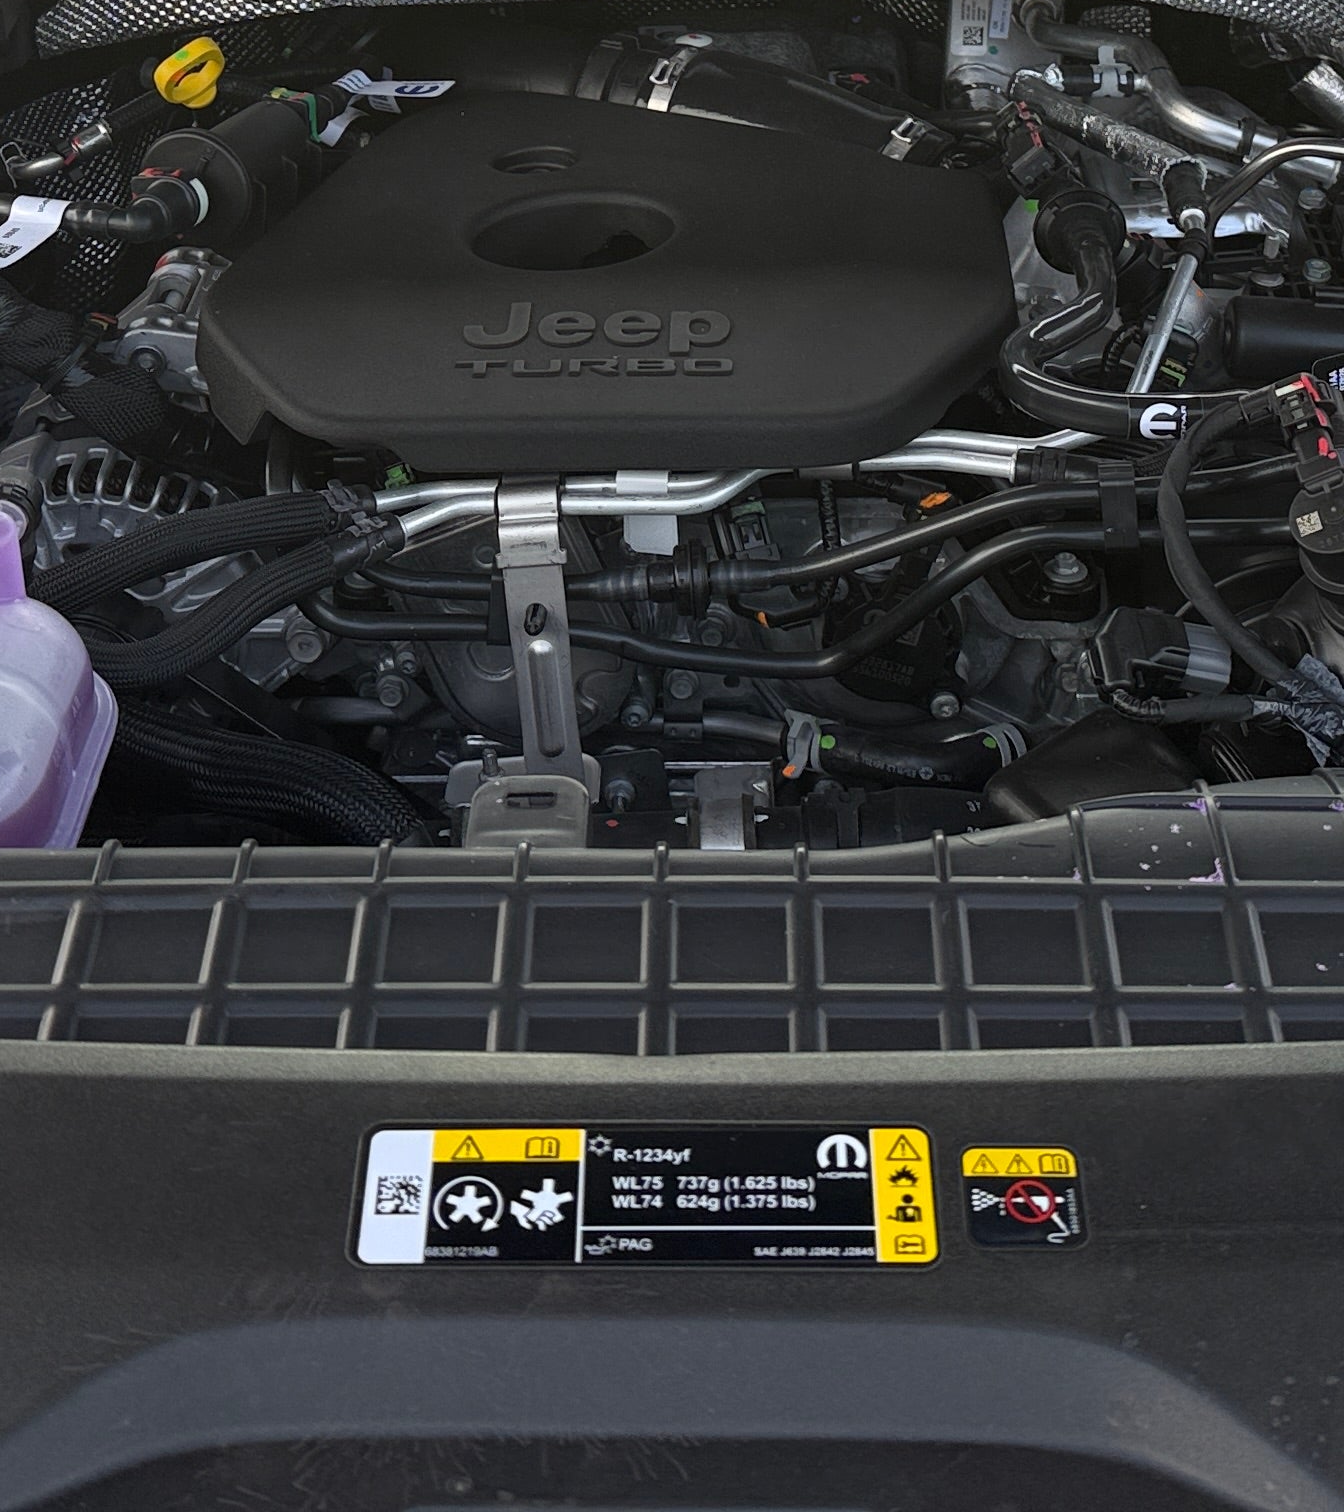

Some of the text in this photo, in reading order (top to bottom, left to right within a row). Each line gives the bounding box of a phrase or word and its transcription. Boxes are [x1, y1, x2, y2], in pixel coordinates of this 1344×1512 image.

[462, 301, 731, 357] Jeep
[454, 357, 734, 379] TURBO
[612, 1148, 691, 1165] R-1234yf
[611, 1176, 816, 1193] WL75 737g (1.625 lbs)
[611, 1194, 817, 1212] WL74 624g (1.375 lbs)
[619, 1237, 654, 1251] PAG
[753, 1246, 778, 1257] SAE
[780, 1246, 806, 1257] J639
